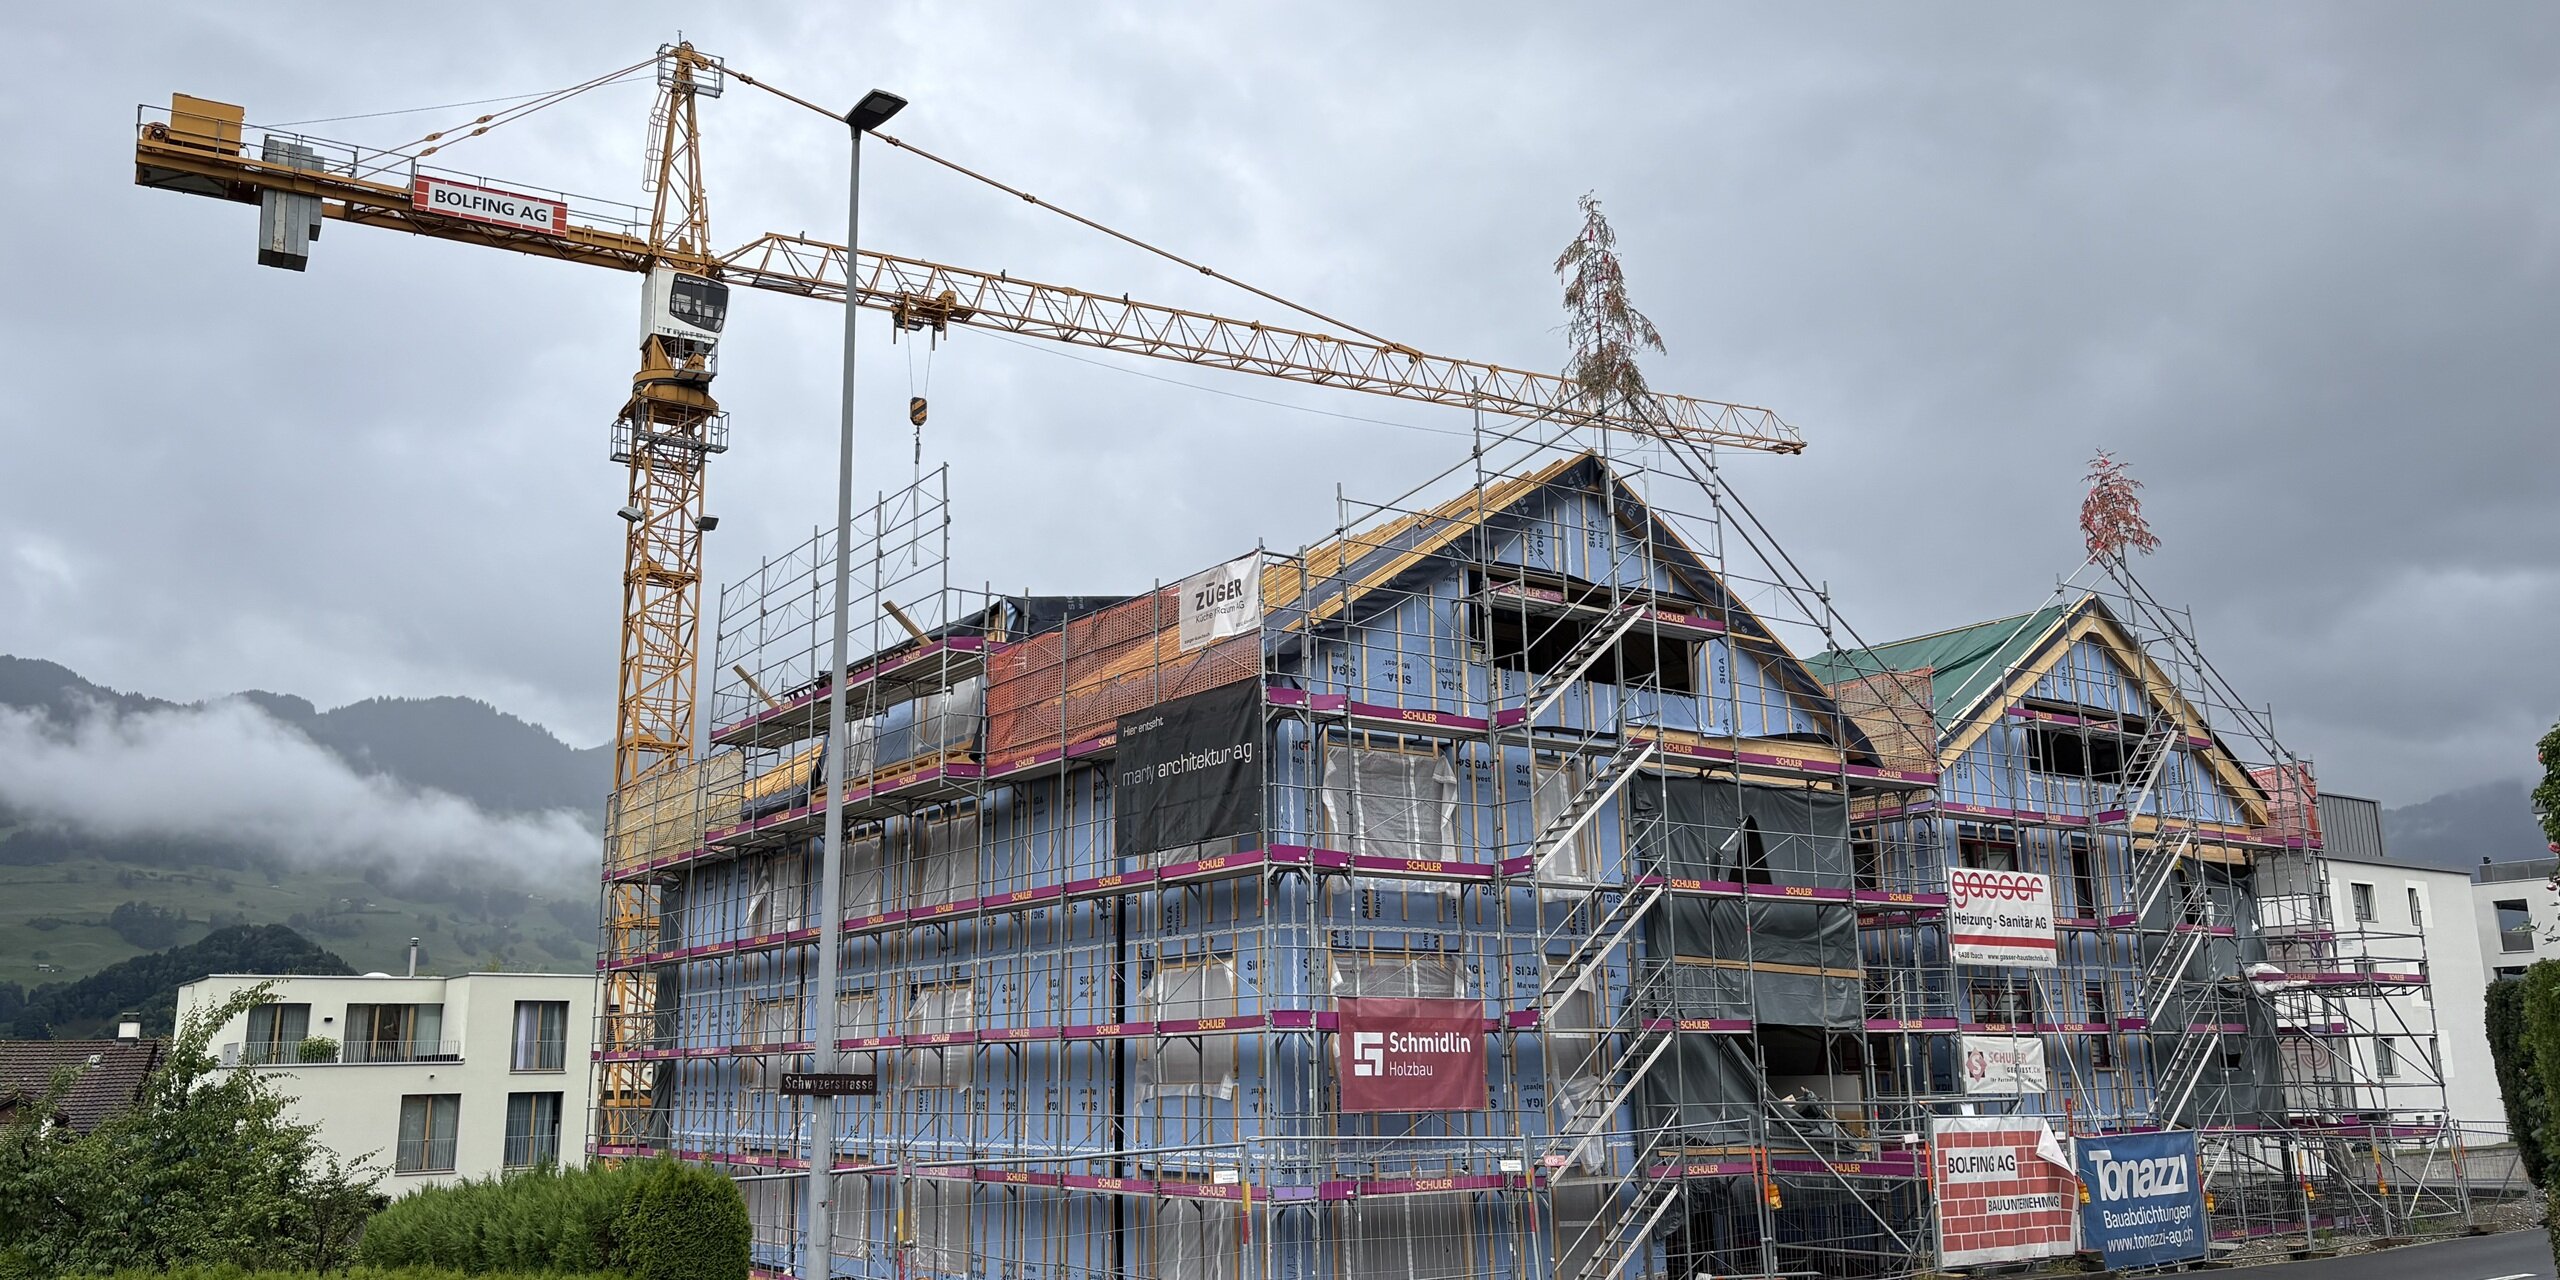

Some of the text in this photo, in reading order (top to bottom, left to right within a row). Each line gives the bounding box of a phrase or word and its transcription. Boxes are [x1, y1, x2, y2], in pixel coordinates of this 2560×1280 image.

[435, 188, 547, 222] BOLFING AG
[1588, 521, 1596, 549] SIGA
[1536, 528, 1544, 557] SIGA
[1195, 578, 1243, 612] ZÜGER
[1507, 586, 1541, 598] SCULER
[1656, 611, 1686, 624] SCHULER
[1718, 657, 1726, 685] SIGA
[1402, 710, 1437, 723] SCHULER
[1123, 725, 1138, 738] Hier
[1664, 742, 1693, 755] SCHULER
[1015, 756, 1035, 769] SCHULER
[1122, 742, 1253, 787] marty architektur ag
[1464, 758, 1488, 770] SGA
[1775, 756, 1803, 768] SCHULER
[1877, 768, 1902, 779] SCHULER
[1965, 804, 1986, 814] SCHULER
[1849, 811, 1865, 820] ULER
[1197, 857, 1225, 871] SCHULER
[1406, 860, 1442, 872] SCHULER
[1098, 875, 1122, 887] SCHULER
[1671, 878, 1701, 889] SCHULER
[1785, 886, 1813, 897] SCHULER
[1952, 870, 2044, 909] gasser
[1011, 890, 1033, 902] SCHULER
[1889, 892, 1914, 903] SCHULER
[1953, 912, 1992, 930] Heizung
[1999, 914, 2033, 929] Sanitär
[2035, 917, 2047, 930] AG
[1096, 1024, 1120, 1035] SCHULER
[1197, 1018, 1226, 1030] SCHULER
[1680, 1019, 1711, 1030] SCHULER
[1898, 1020, 1923, 1029] SHULER
[1984, 1023, 2007, 1032] SCHULER
[2063, 1024, 2084, 1032] SCHULER
[1008, 1029, 1030, 1038] SCHULER
[1389, 1031, 1471, 1053] Schmidlin
[1389, 1061, 1433, 1077] Holzbau
[785, 1075, 873, 1091] Schwyzerstrasse
[1688, 1164, 1719, 1175] SCHULER
[1827, 1162, 1861, 1173] CHULER
[1948, 1155, 2016, 1173] BOLFING AG
[1006, 1172, 1028, 1182] SCHULER
[2088, 1149, 2189, 1201] Tonazzi
[1097, 1178, 1122, 1189] SCHULER
[1416, 1179, 1453, 1191] SCHULER
[1198, 1185, 1227, 1197] SCHULER
[2103, 1204, 2192, 1229] Bauabdichtungen
[2107, 1225, 2194, 1253] www.tonazzi-ag.ch
